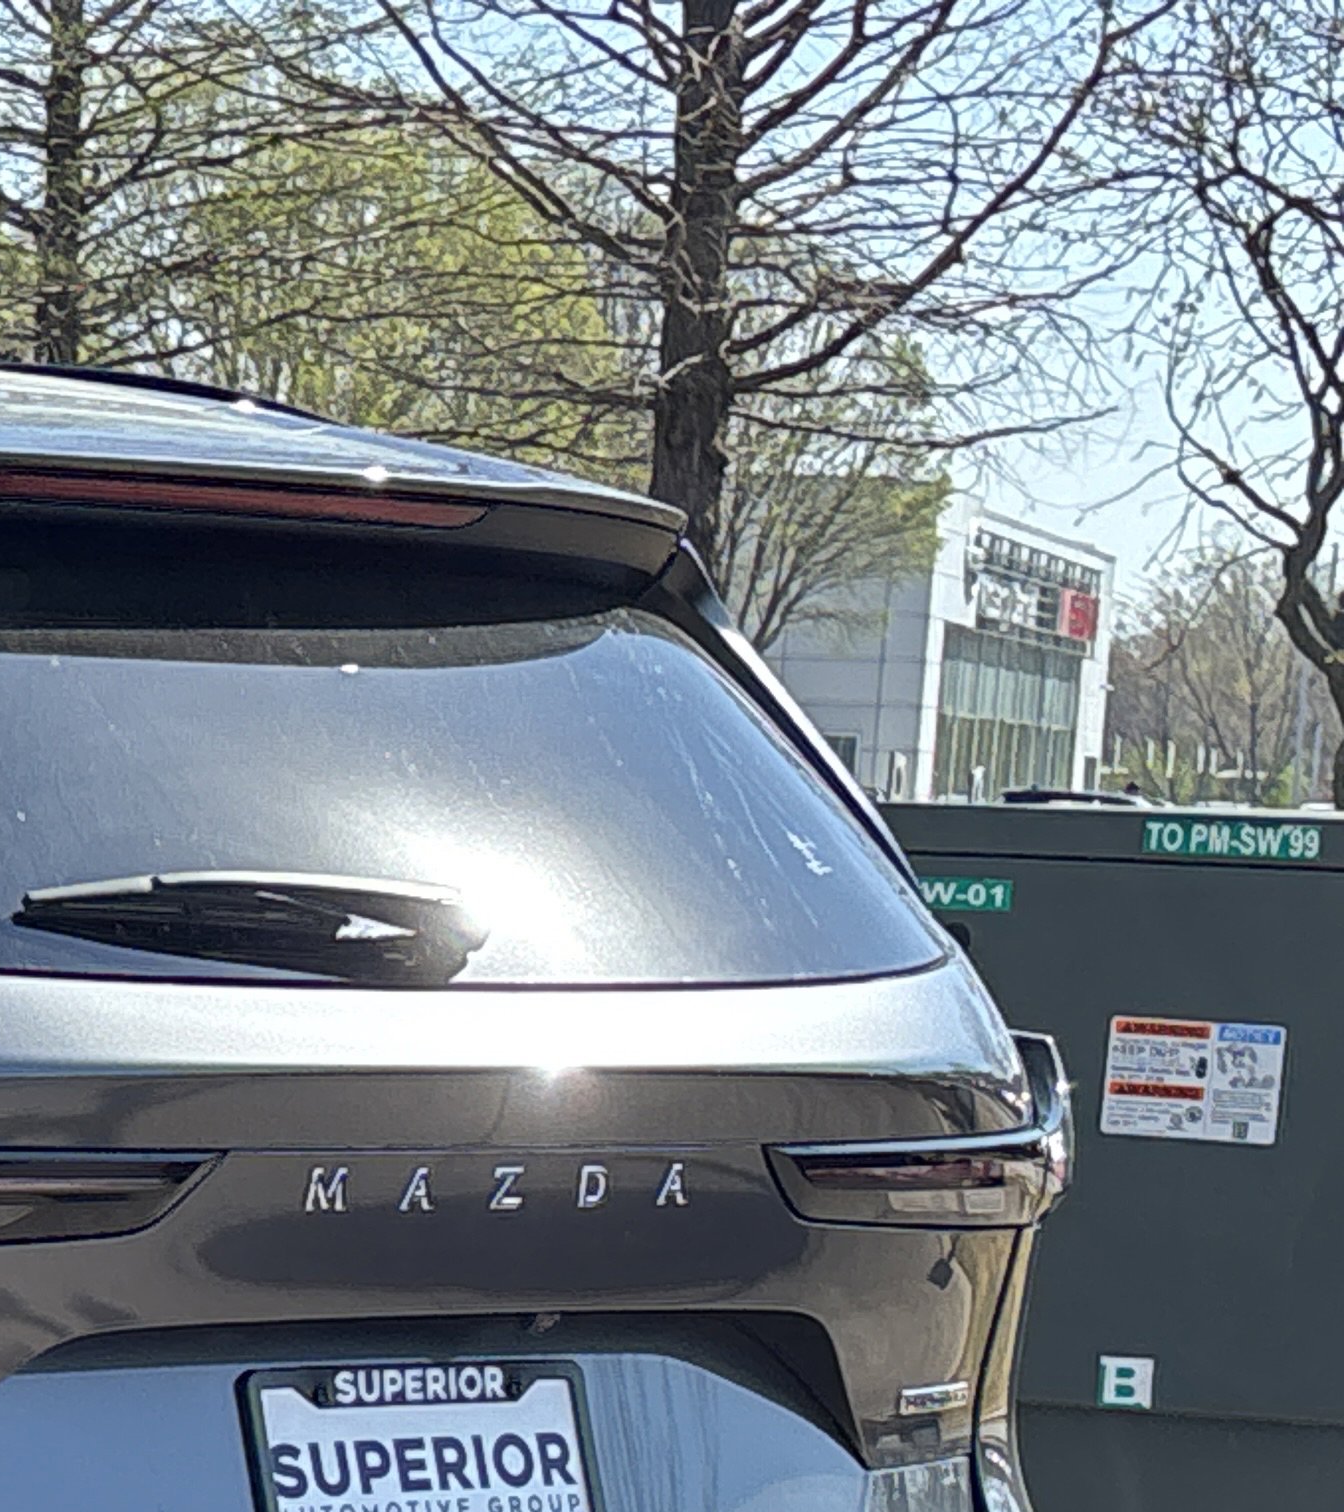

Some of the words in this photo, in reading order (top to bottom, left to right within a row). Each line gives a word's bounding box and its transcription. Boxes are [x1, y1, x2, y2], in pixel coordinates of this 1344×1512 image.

[1145, 820, 1184, 851] TO
[304, 1163, 690, 1213] MAZDA
[333, 1366, 507, 1405] SUPERIOR
[1101, 1357, 1151, 1406] B
[271, 1431, 578, 1500] SUPERIOR
